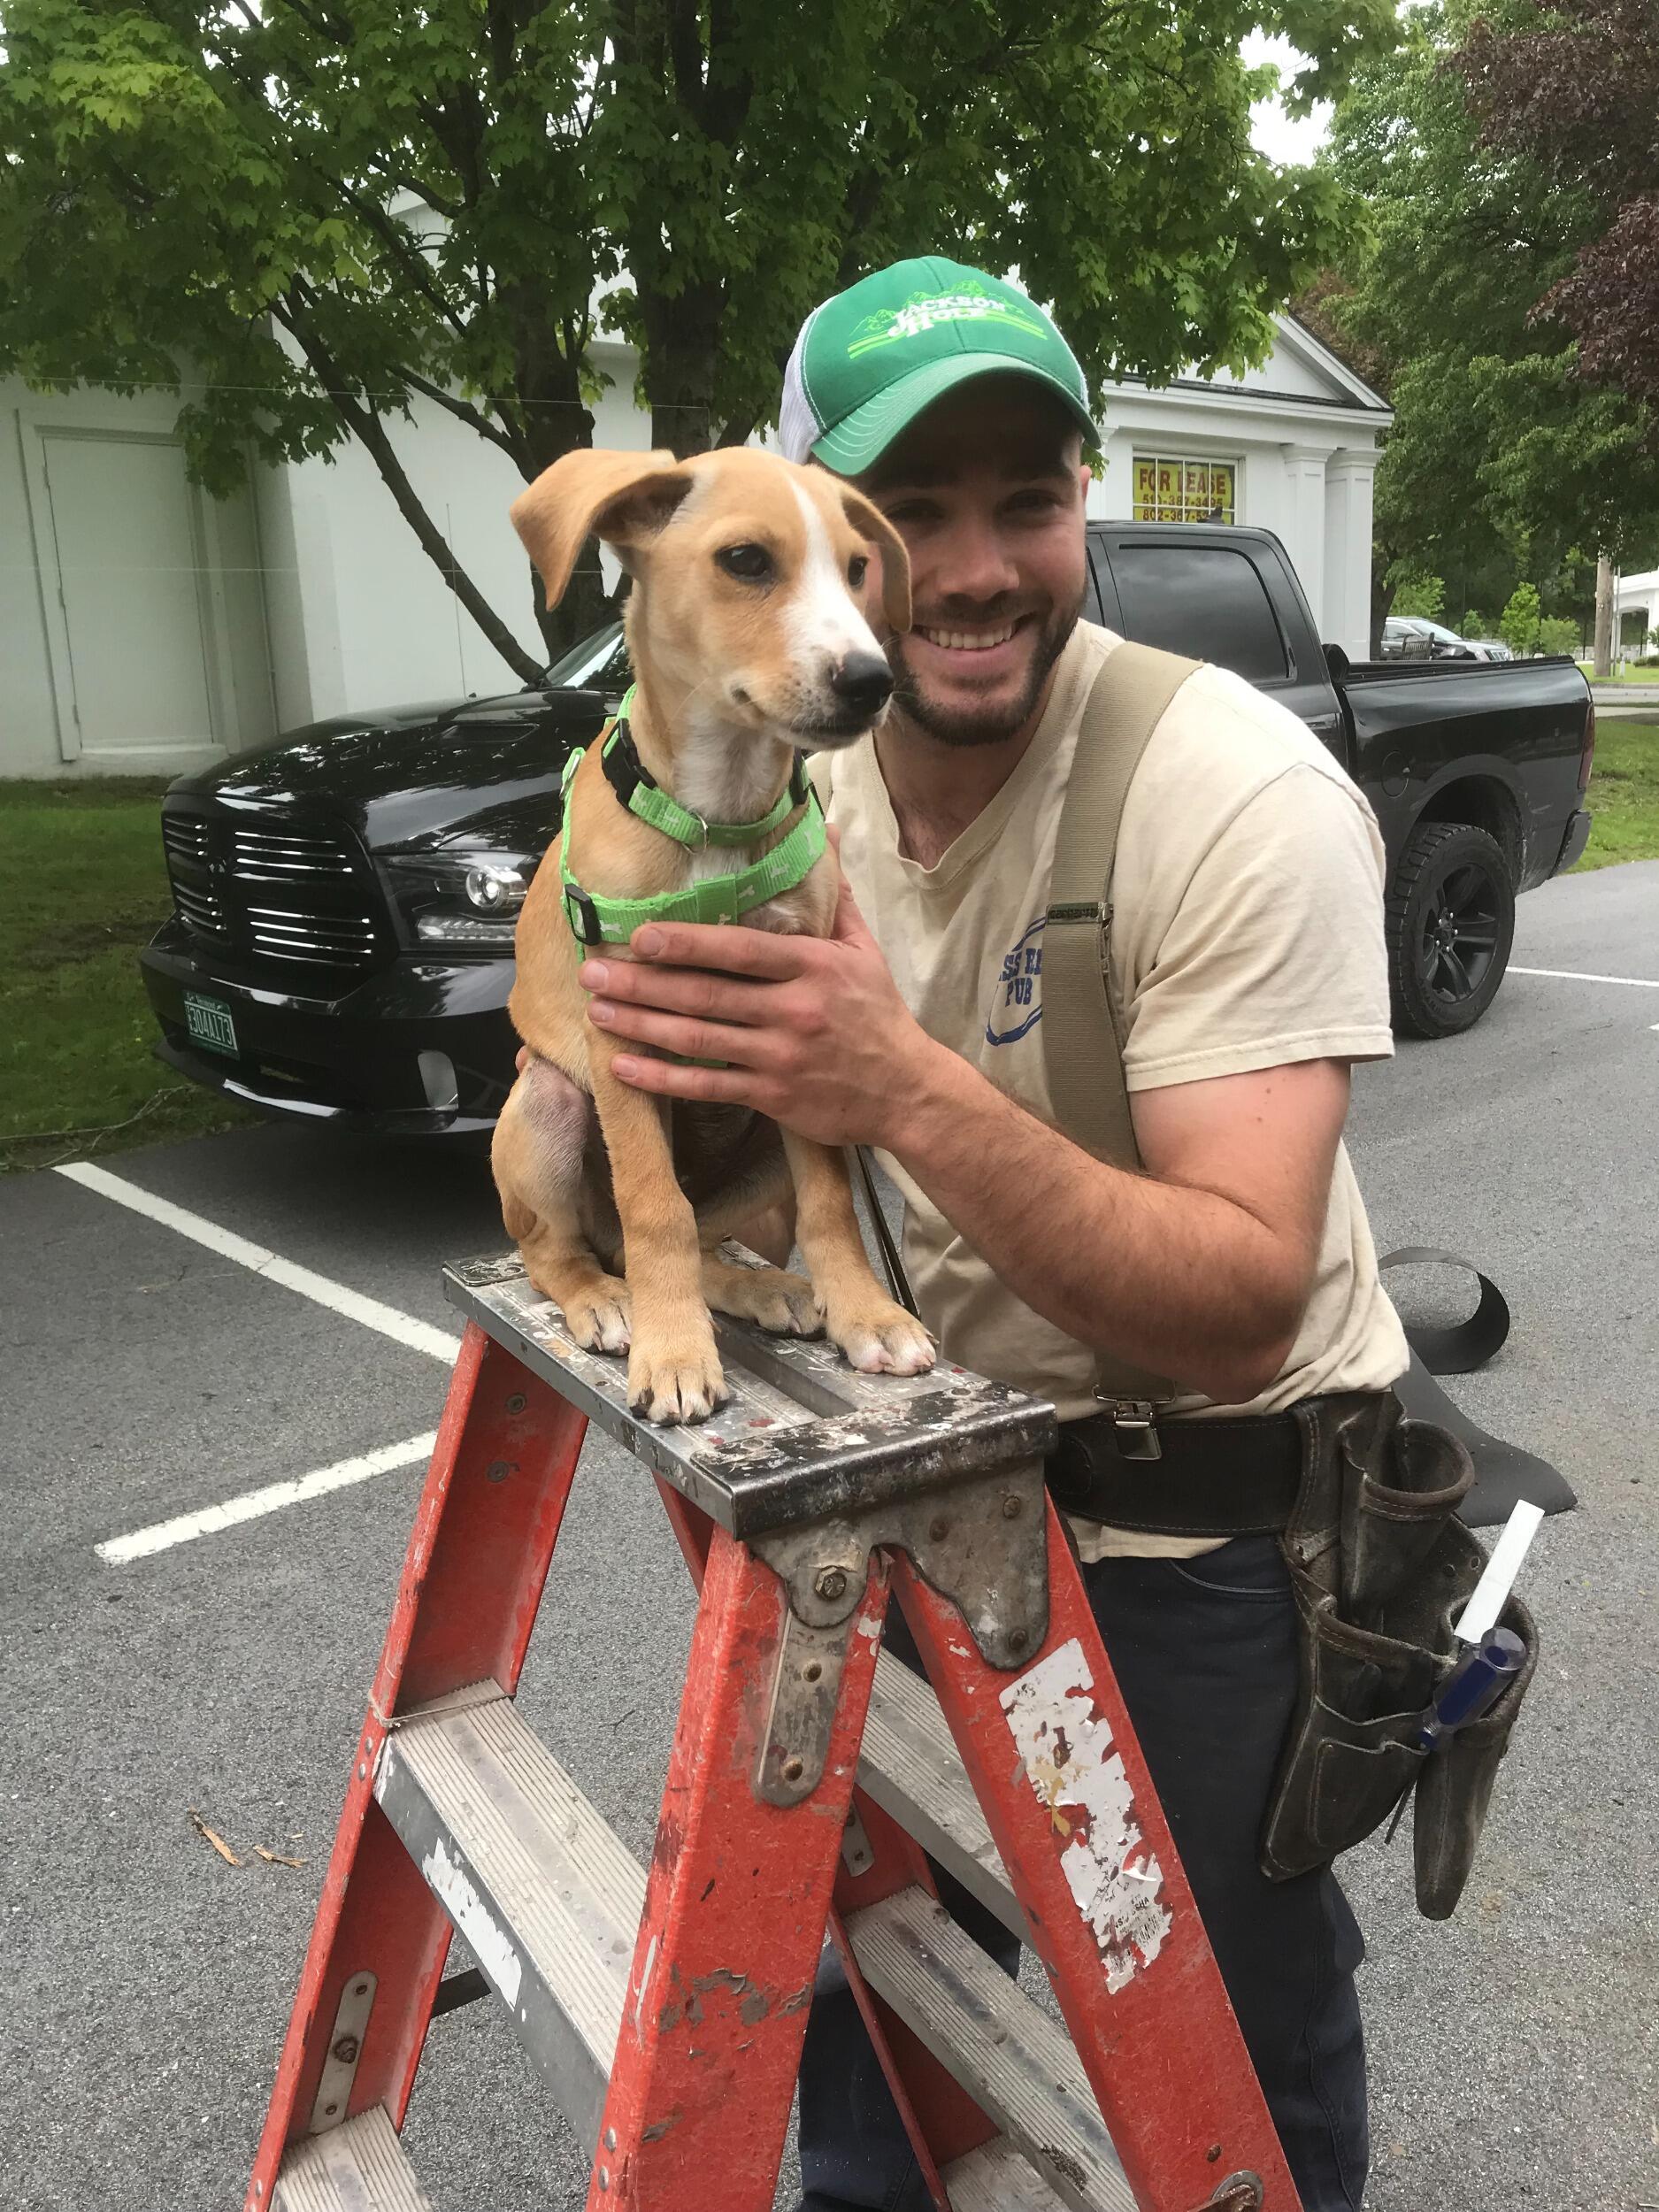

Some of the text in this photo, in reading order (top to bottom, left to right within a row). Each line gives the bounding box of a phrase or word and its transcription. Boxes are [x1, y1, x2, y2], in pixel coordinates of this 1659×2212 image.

[887, 295, 1006, 338] JACKSON
[905, 306, 987, 338] HOLE
[1140, 467, 1226, 495] FOR LEASE
[1004, 977, 1033, 1008] PUB
